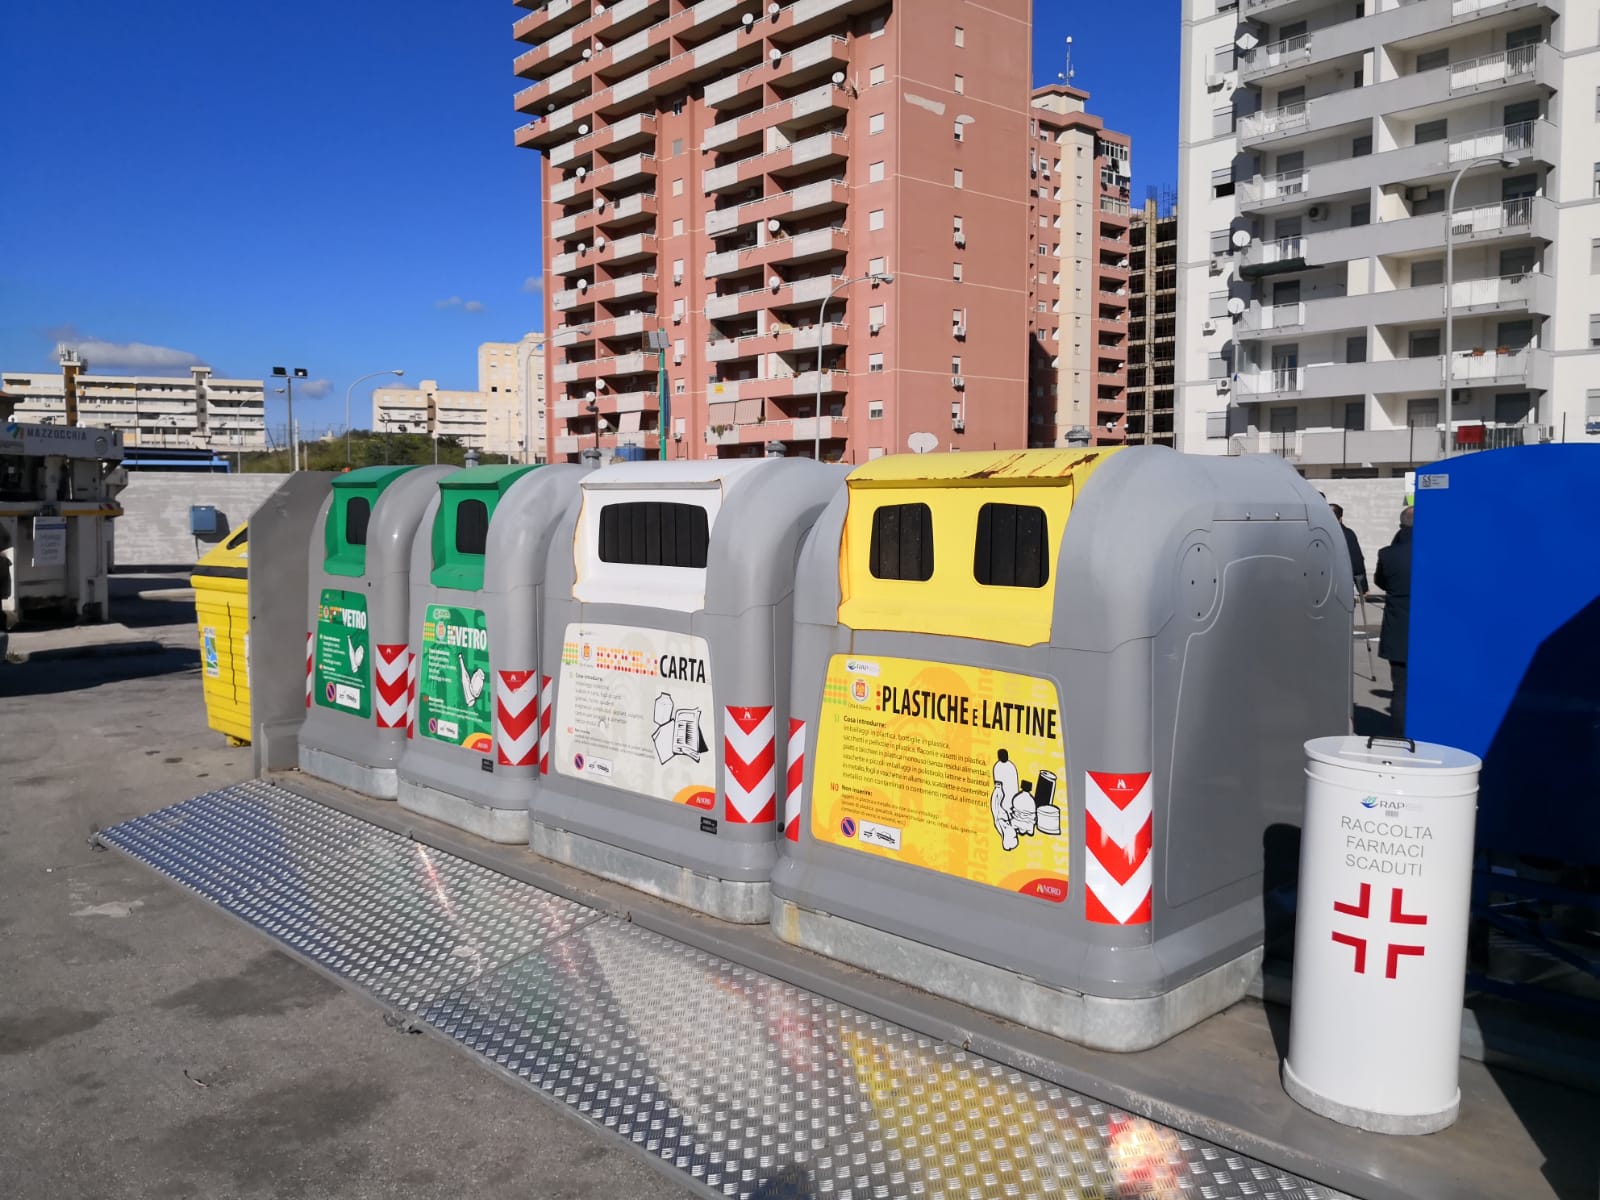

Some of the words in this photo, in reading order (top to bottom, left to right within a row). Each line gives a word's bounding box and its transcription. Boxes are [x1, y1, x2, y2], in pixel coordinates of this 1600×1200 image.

[27, 428, 87, 440] MAZZOCCHIA
[342, 608, 367, 630] VETRO
[455, 625, 487, 650] VETRO
[660, 654, 706, 683] CARTA
[882, 685, 969, 724] PLASTICHE
[972, 708, 978, 726] E
[982, 699, 1057, 739] LATTINE
[1380, 800, 1405, 810] RAP
[1341, 815, 1433, 840] RACCOLTA
[1346, 835, 1424, 858] FARMACI
[1345, 853, 1422, 877] SCADUTI
